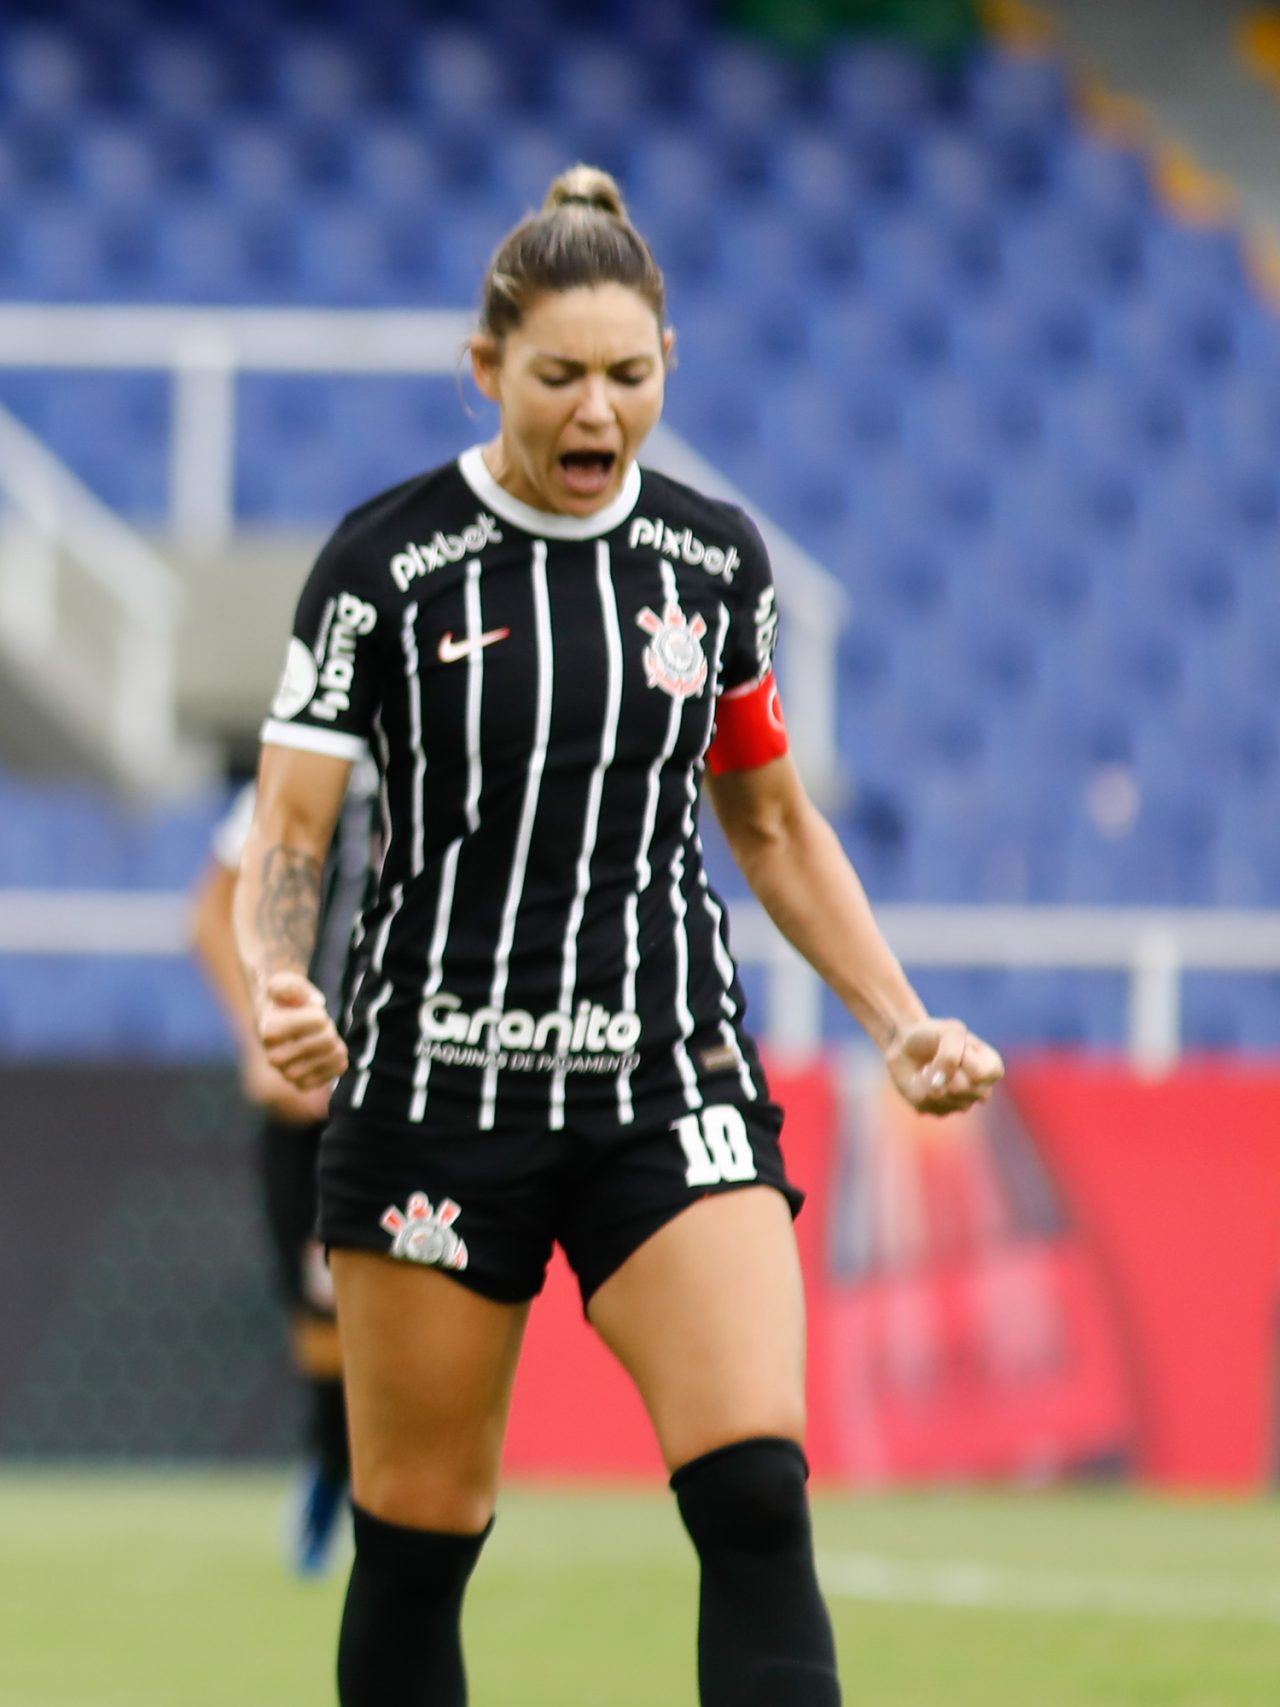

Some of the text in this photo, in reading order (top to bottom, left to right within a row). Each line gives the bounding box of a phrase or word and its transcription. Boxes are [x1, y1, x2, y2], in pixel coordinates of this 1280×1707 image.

[390, 512, 503, 593] pixbet
[629, 517, 741, 585] pixbet
[321, 591, 378, 692] bmg
[418, 992, 642, 1052] Granito
[509, 1052, 537, 1071] DE
[538, 1053, 641, 1073] PAGAMENTO
[669, 1104, 758, 1188] 10
